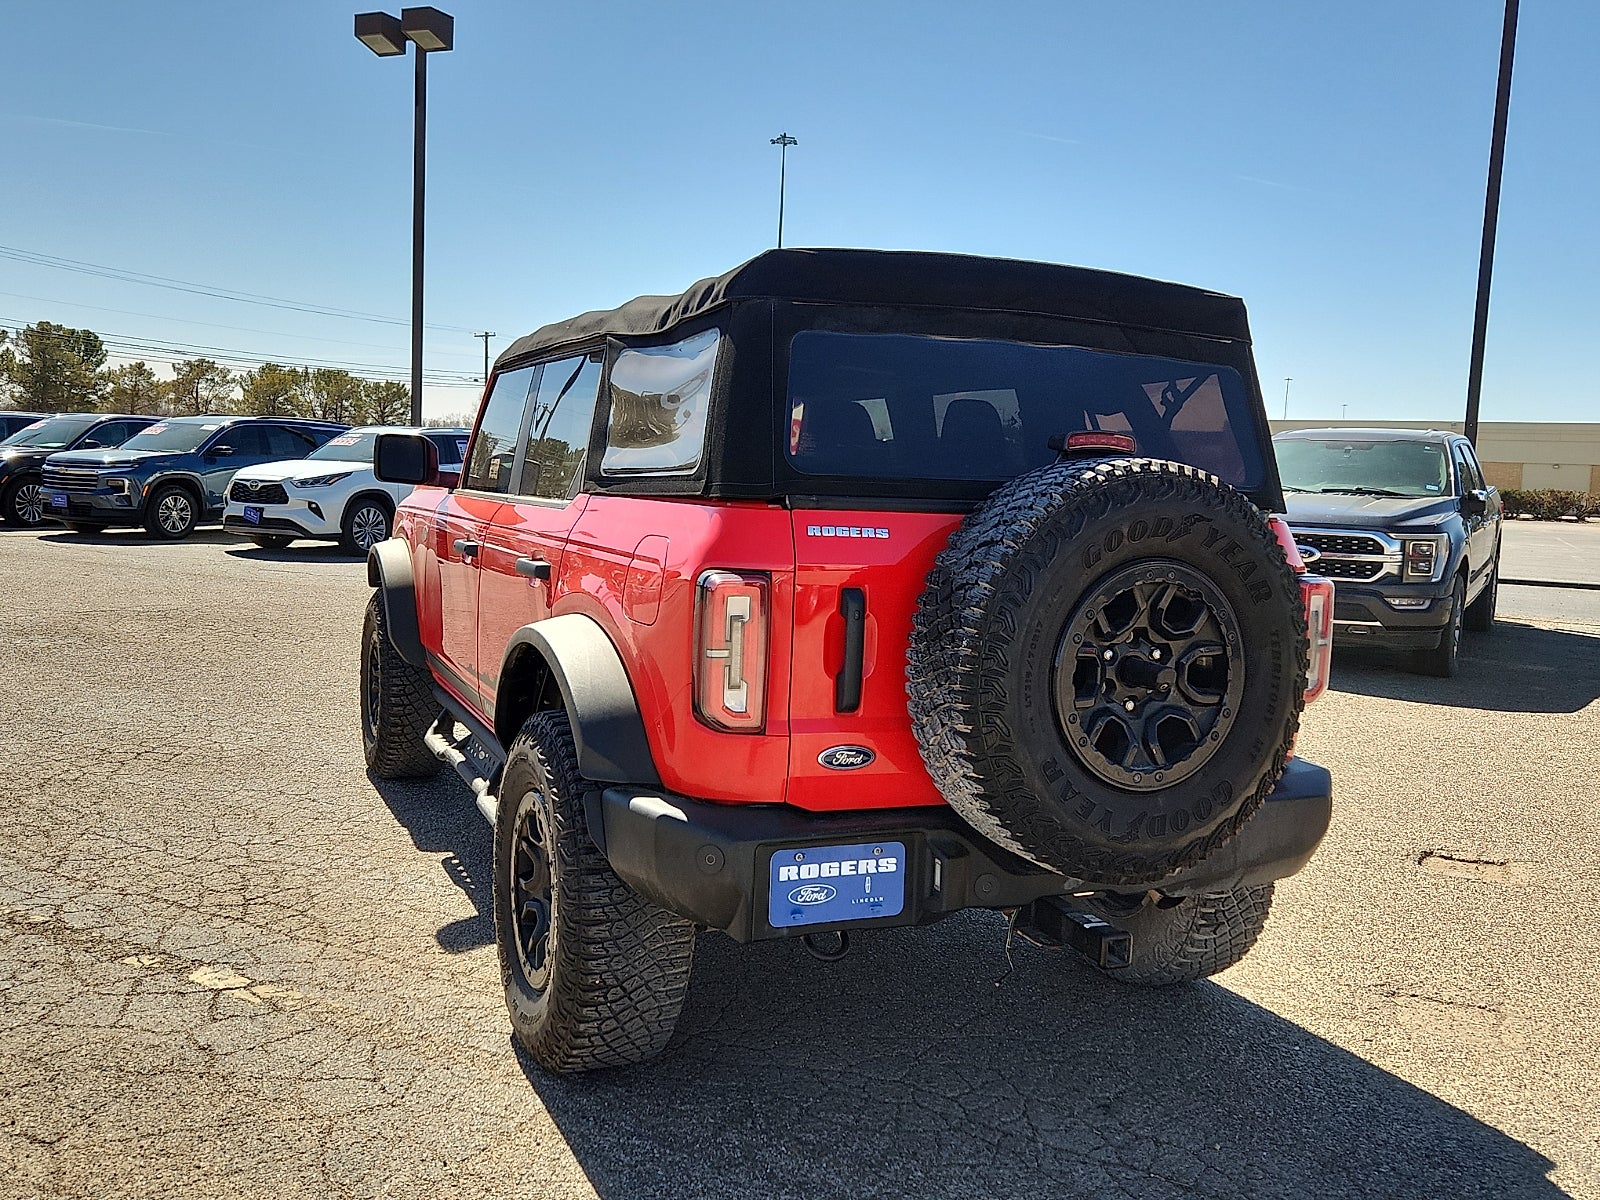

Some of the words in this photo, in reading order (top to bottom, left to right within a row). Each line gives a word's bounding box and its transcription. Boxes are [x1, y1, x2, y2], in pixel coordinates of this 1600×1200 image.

[807, 525, 889, 539] ROGERS
[832, 750, 864, 765] Ford
[778, 857, 898, 882] ROGERS
[797, 886, 827, 903] Ford
[851, 896, 884, 904] LINCOLN
